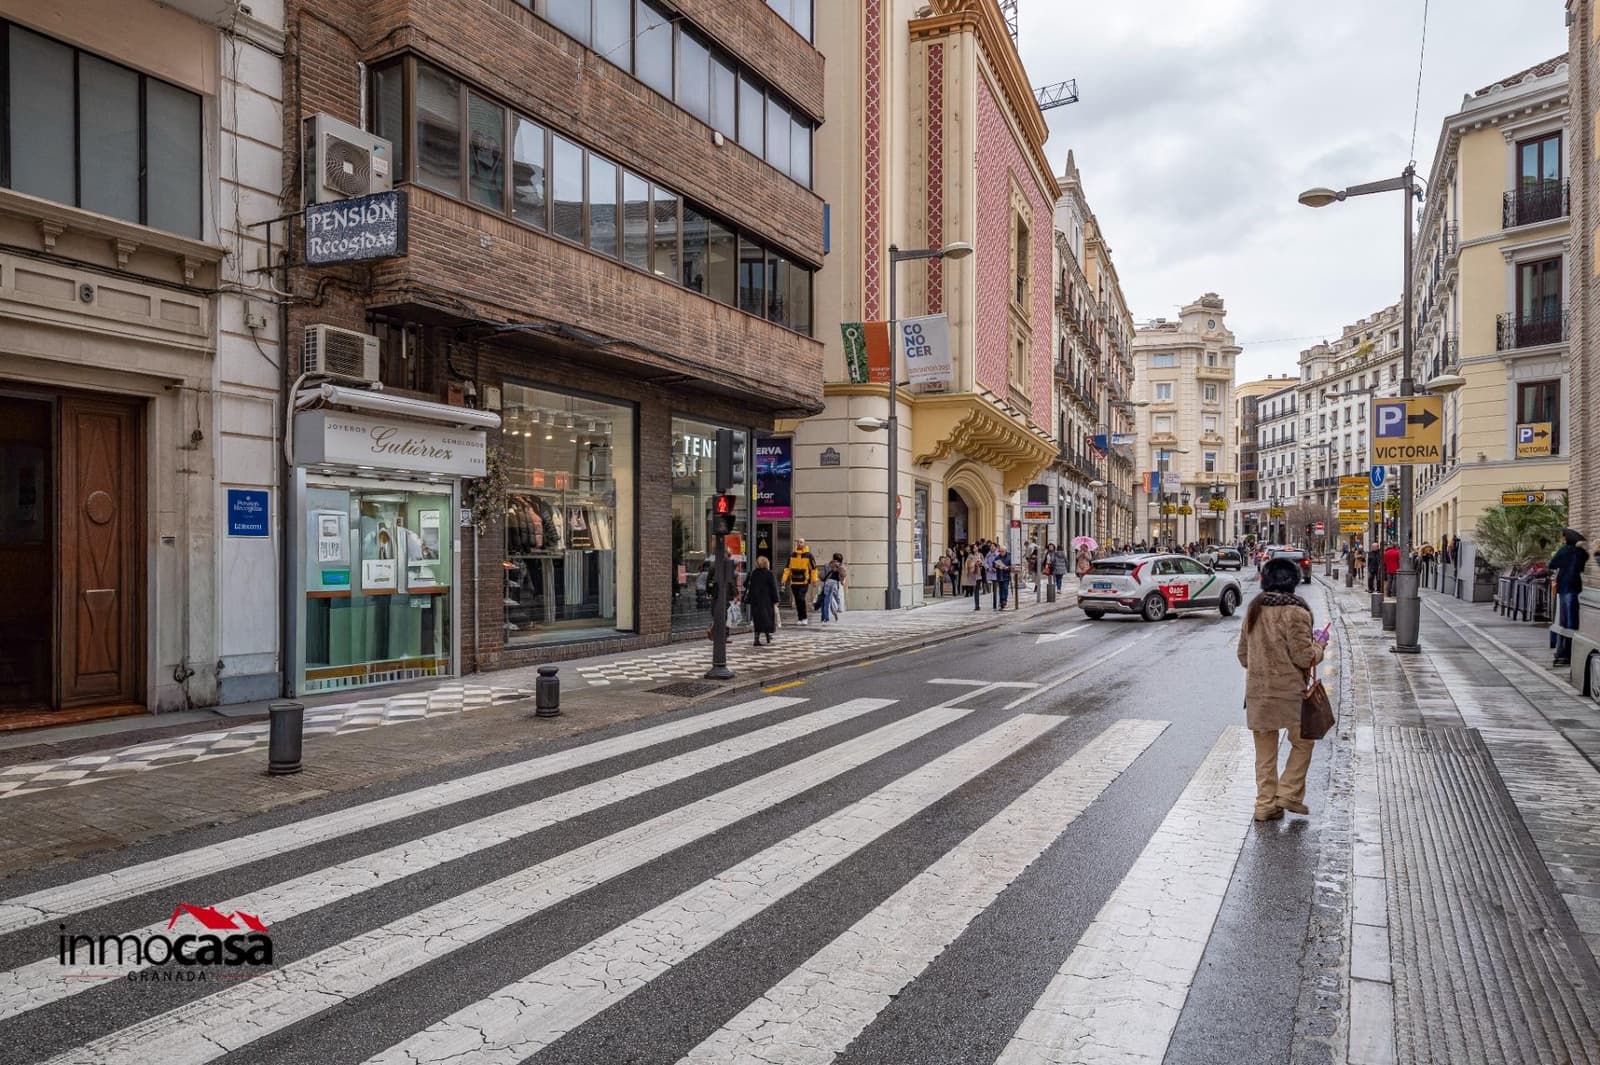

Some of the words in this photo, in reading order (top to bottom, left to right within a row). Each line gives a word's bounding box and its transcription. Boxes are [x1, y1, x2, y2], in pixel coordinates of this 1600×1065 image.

[310, 199, 396, 233] PENSIÓN
[310, 231, 396, 256] Recogidas
[903, 323, 922, 335] CO
[905, 335, 925, 347] NO
[907, 345, 932, 358] CER
[1379, 406, 1402, 435] P
[1520, 429, 1532, 442] P
[683, 435, 717, 458] TEN
[1376, 445, 1439, 459] VICTORIA
[1518, 445, 1549, 453] VICTORIA
